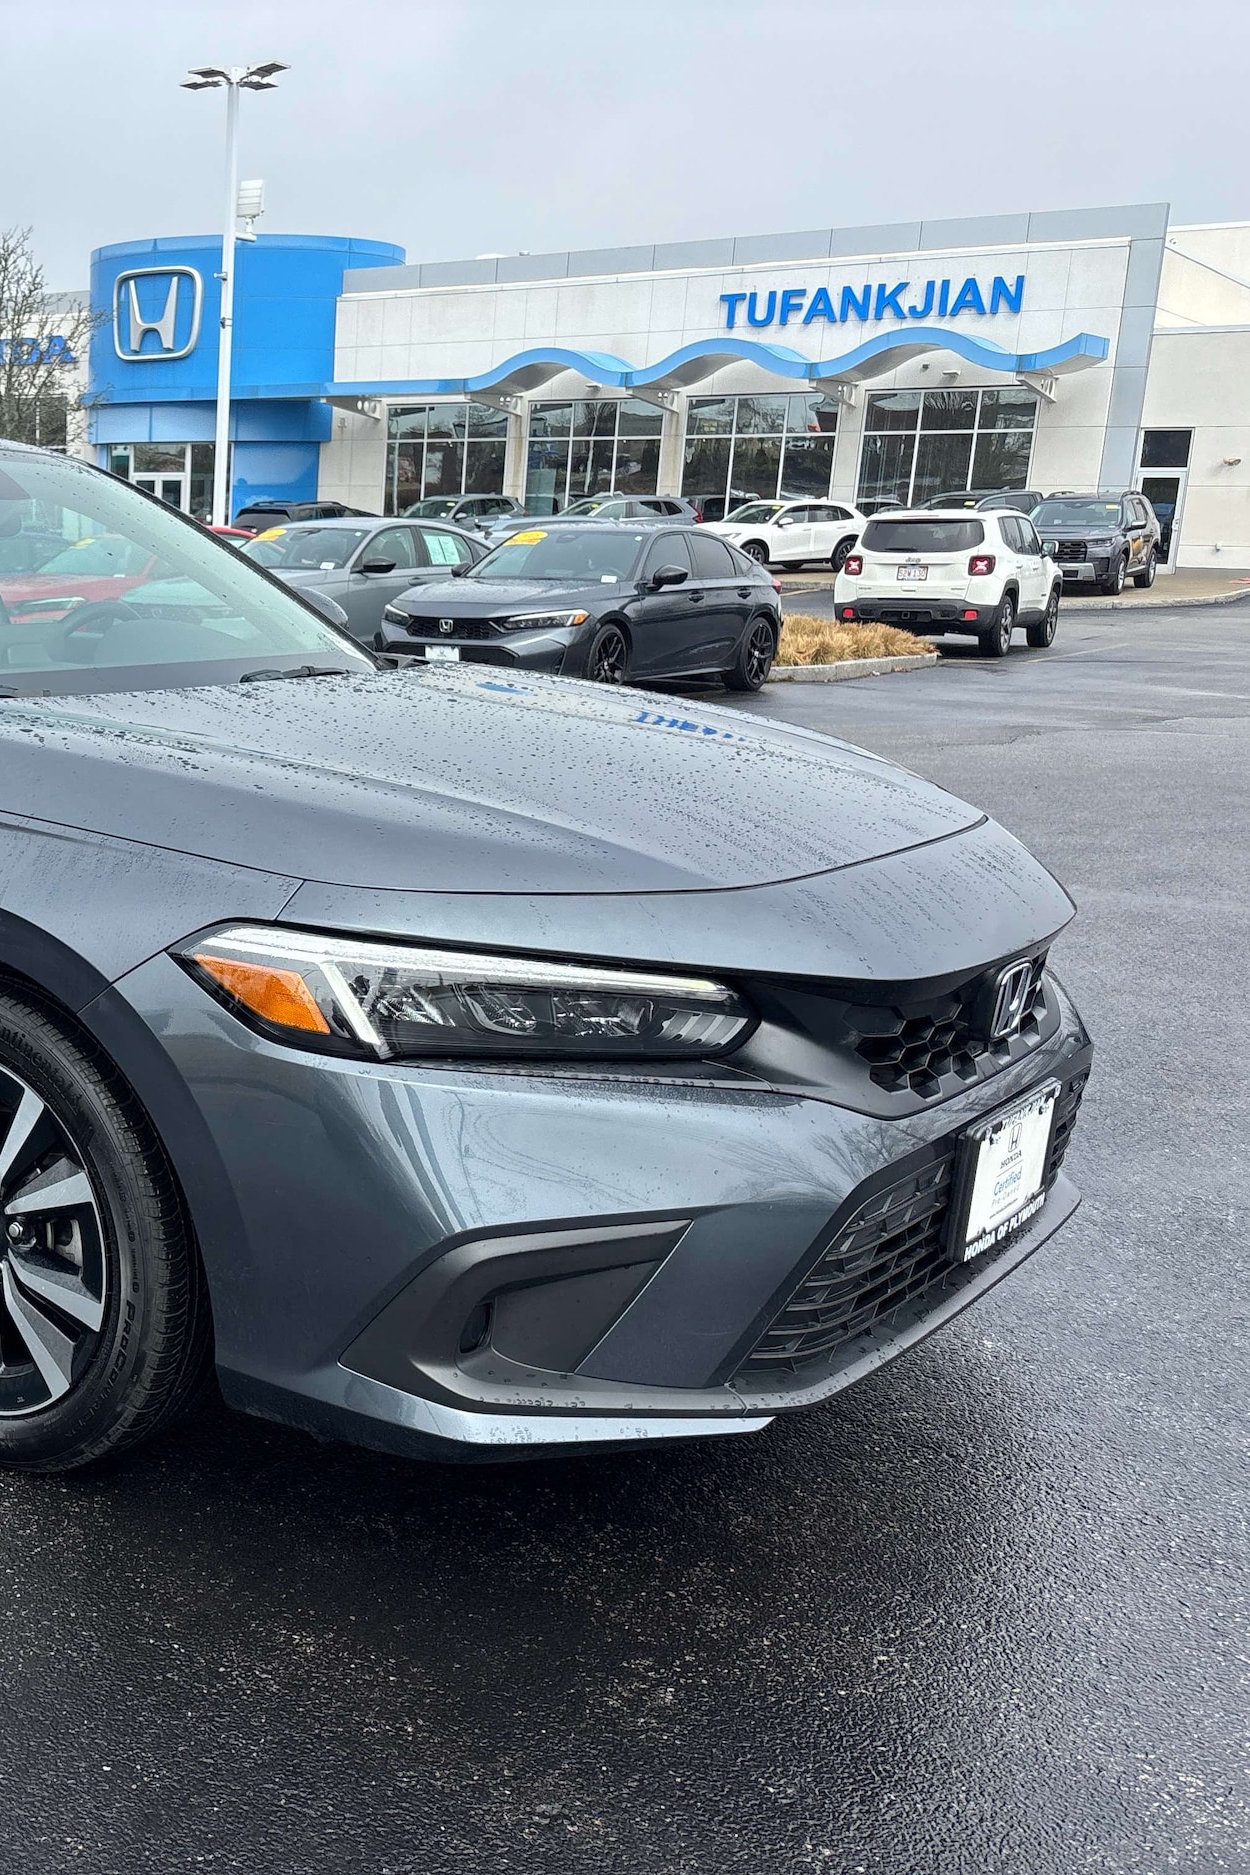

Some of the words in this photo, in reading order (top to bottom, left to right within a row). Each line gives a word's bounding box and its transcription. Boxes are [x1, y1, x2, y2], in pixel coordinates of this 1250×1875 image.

[719, 274, 1025, 329] TUFANKJIAN
[994, 1165, 1022, 1196] Certified
[1000, 1150, 1022, 1169] HONDA
[964, 1232, 996, 1262] HONDA
[996, 1219, 1009, 1241] OF
[1008, 1191, 1046, 1232] PLYMOUTH
